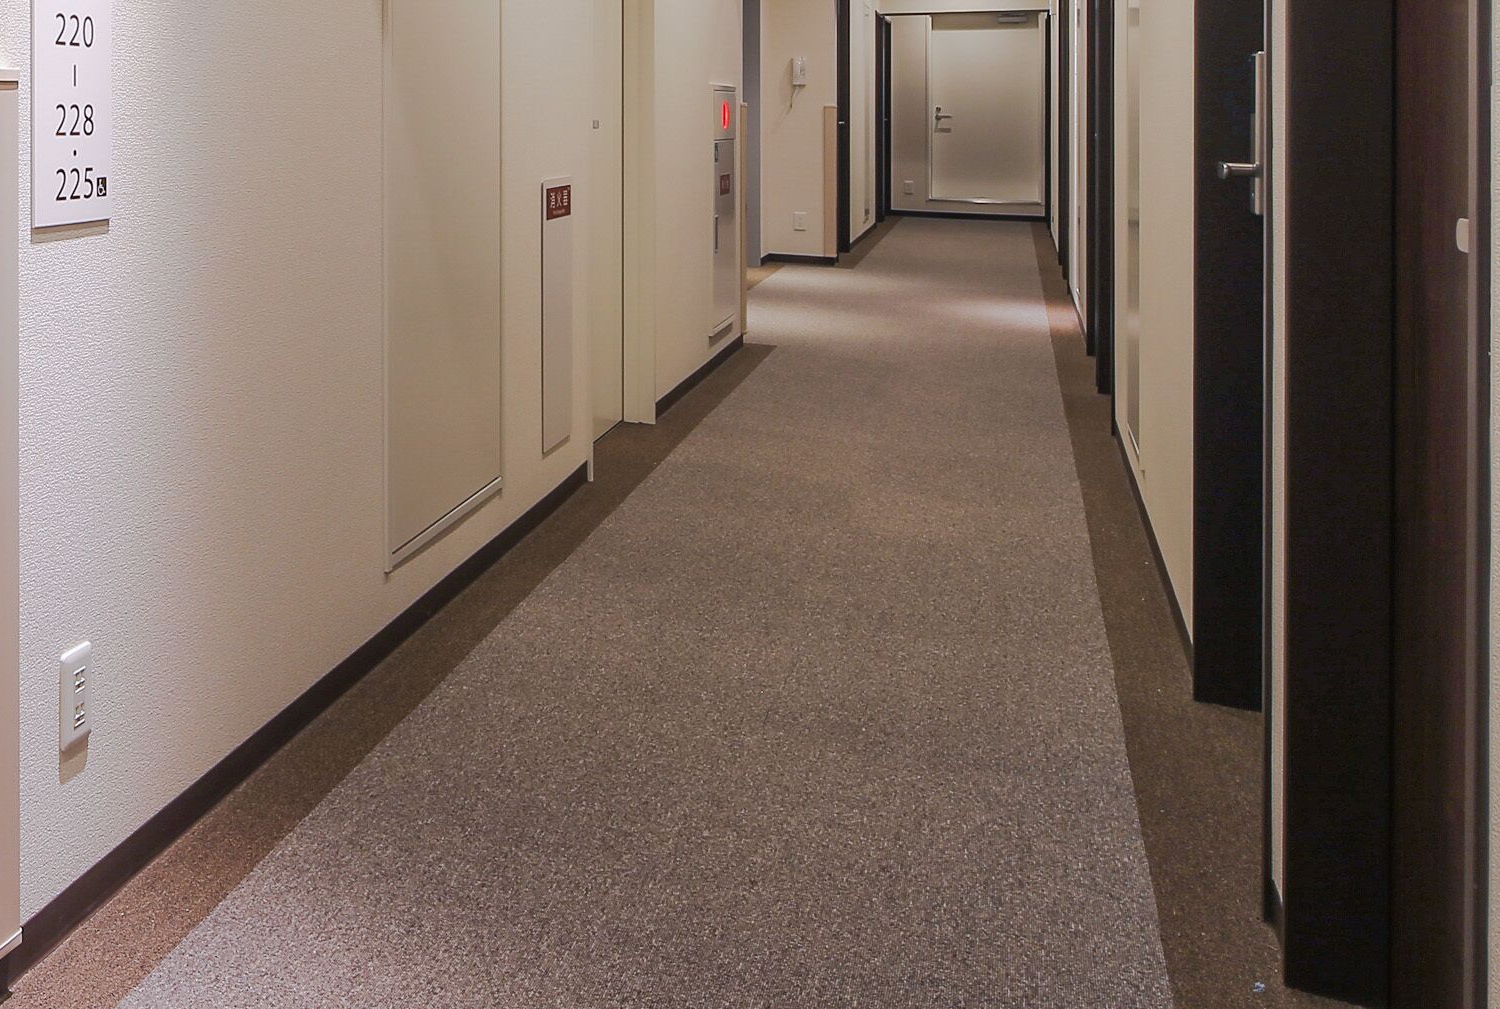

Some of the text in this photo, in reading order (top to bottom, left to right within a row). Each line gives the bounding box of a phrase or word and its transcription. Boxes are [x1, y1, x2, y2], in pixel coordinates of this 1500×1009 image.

[55, 13, 94, 48] 220
[55, 104, 94, 137] 228
[55, 167, 94, 201] 225
